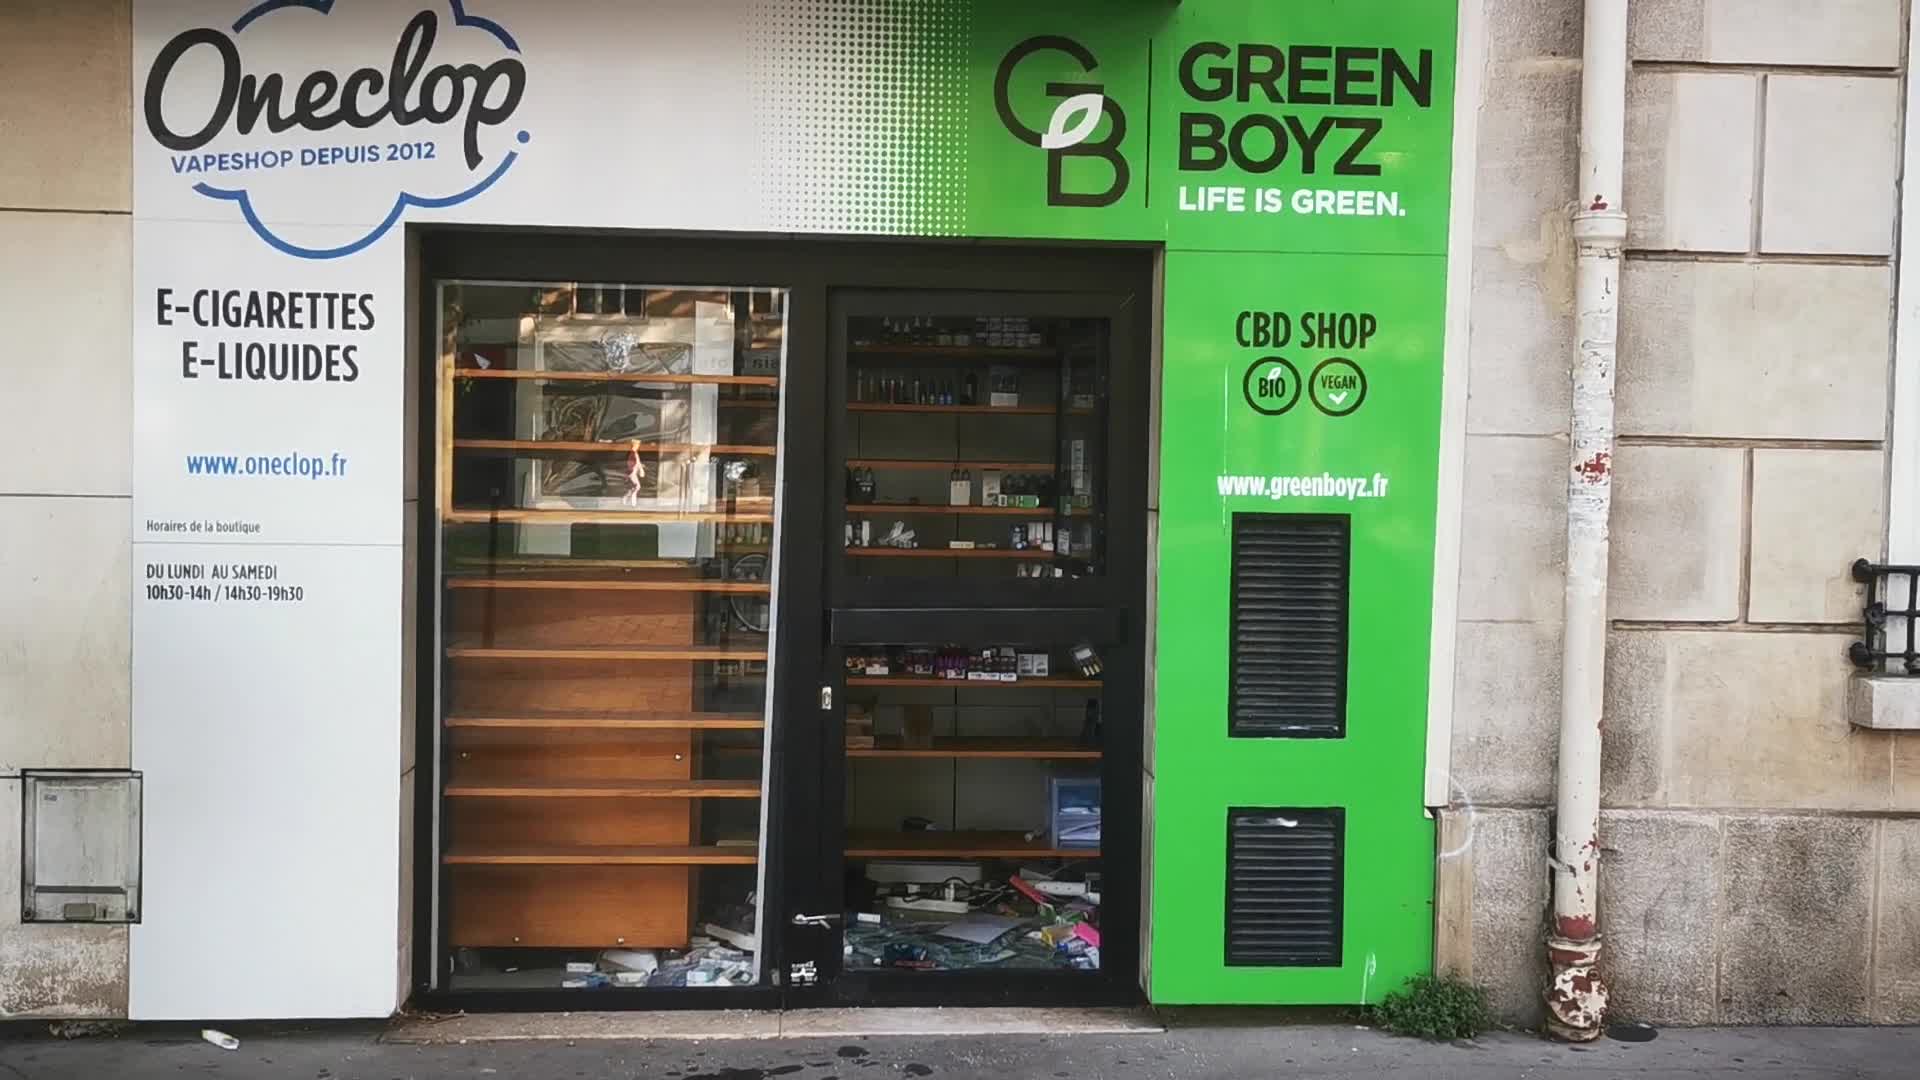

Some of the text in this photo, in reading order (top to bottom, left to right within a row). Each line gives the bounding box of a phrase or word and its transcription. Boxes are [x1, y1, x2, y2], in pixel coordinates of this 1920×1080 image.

[144, 10, 527, 171] Oneclop
[1179, 42, 1433, 108] GREEN
[171, 141, 436, 174] VAPESHOP DEPUIS 2012
[1178, 112, 1383, 176] BOYZ
[1179, 186, 1407, 217] LIFE IS GREEN.
[157, 288, 376, 331] E-CIGARETTES
[1235, 311, 1377, 349] CBD SHOP
[182, 341, 359, 382] E-LIQUIDES
[1258, 377, 1286, 398] BIO
[1321, 375, 1357, 390] VEGAN
[187, 452, 348, 479] www.oneclop.fr
[1217, 472, 1389, 501] www.greenboyz.fr
[146, 519, 261, 535] Horaires de la boutique
[146, 564, 278, 580] DU LUNDI AU SAMEDI
[146, 584, 212, 601] 10h30-14h
[224, 585, 304, 601] 14h30-19h30
